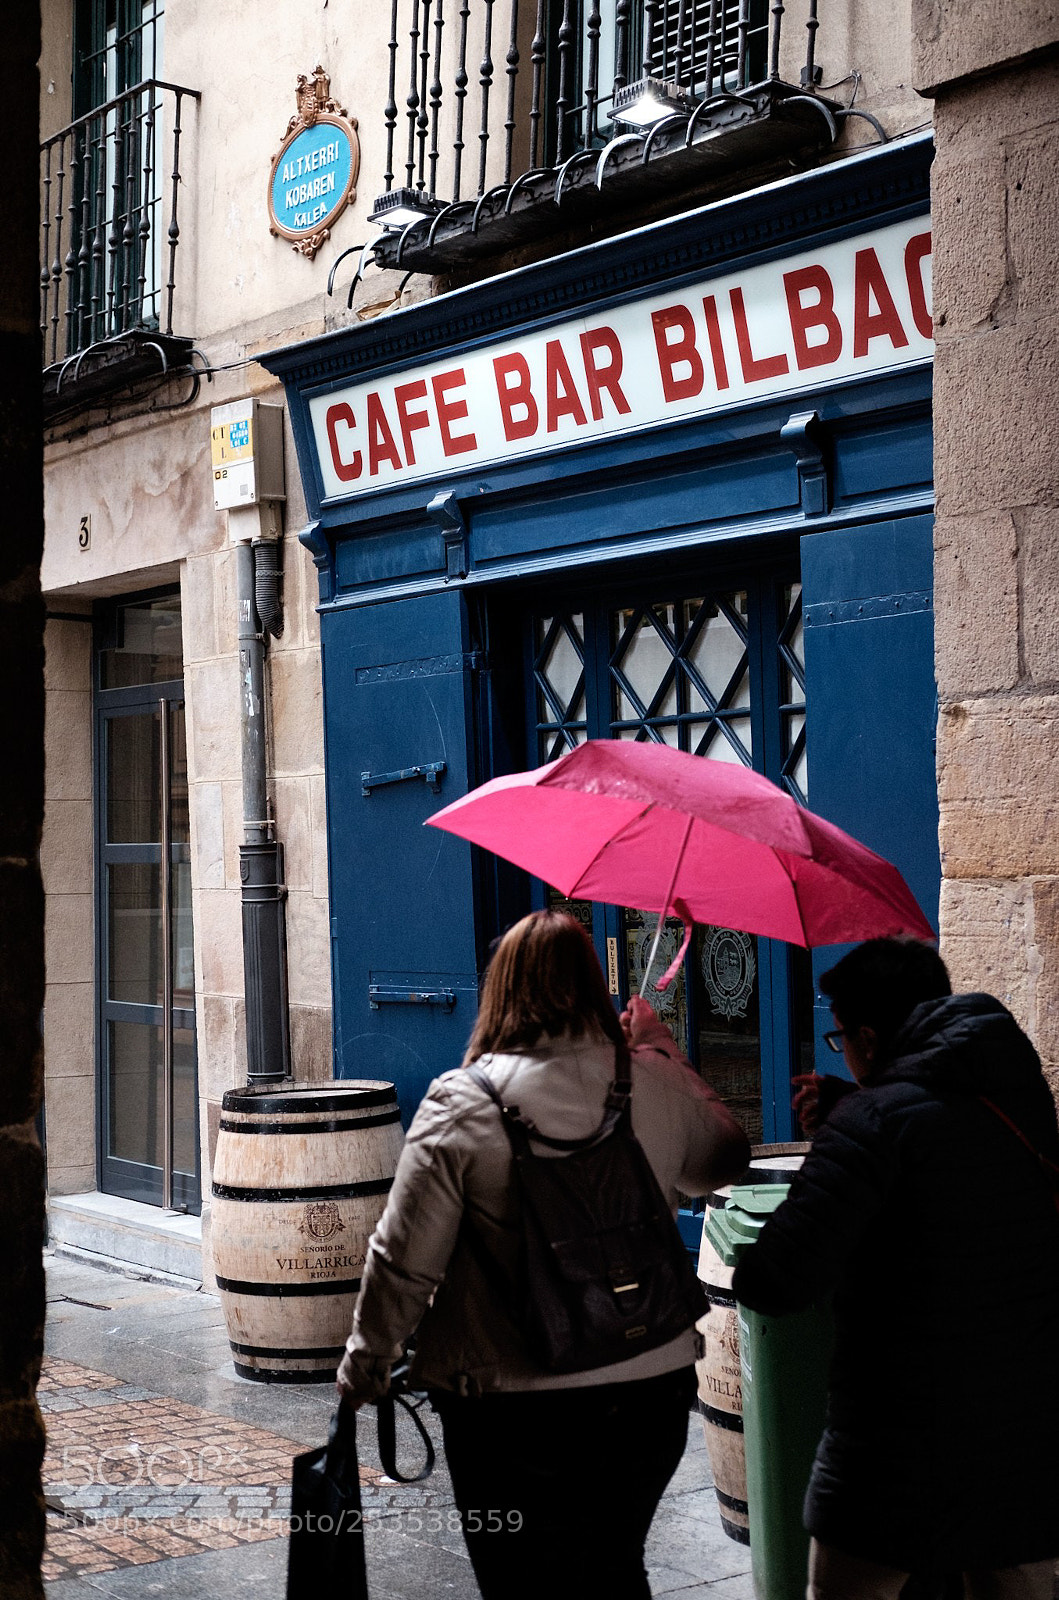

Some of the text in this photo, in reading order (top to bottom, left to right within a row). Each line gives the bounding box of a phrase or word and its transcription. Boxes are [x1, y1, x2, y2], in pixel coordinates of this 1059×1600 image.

[282, 140, 339, 184] ALTXERRI
[285, 171, 335, 209] KOBAREN
[293, 202, 328, 227] KALEA
[326, 367, 478, 482] CAFE
[492, 325, 632, 442] BAR
[78, 516, 89, 548] 3
[276, 1254, 367, 1270] VILLARRICA
[334, 1244, 346, 1252] DE
[310, 1271, 337, 1279] RIOJA
